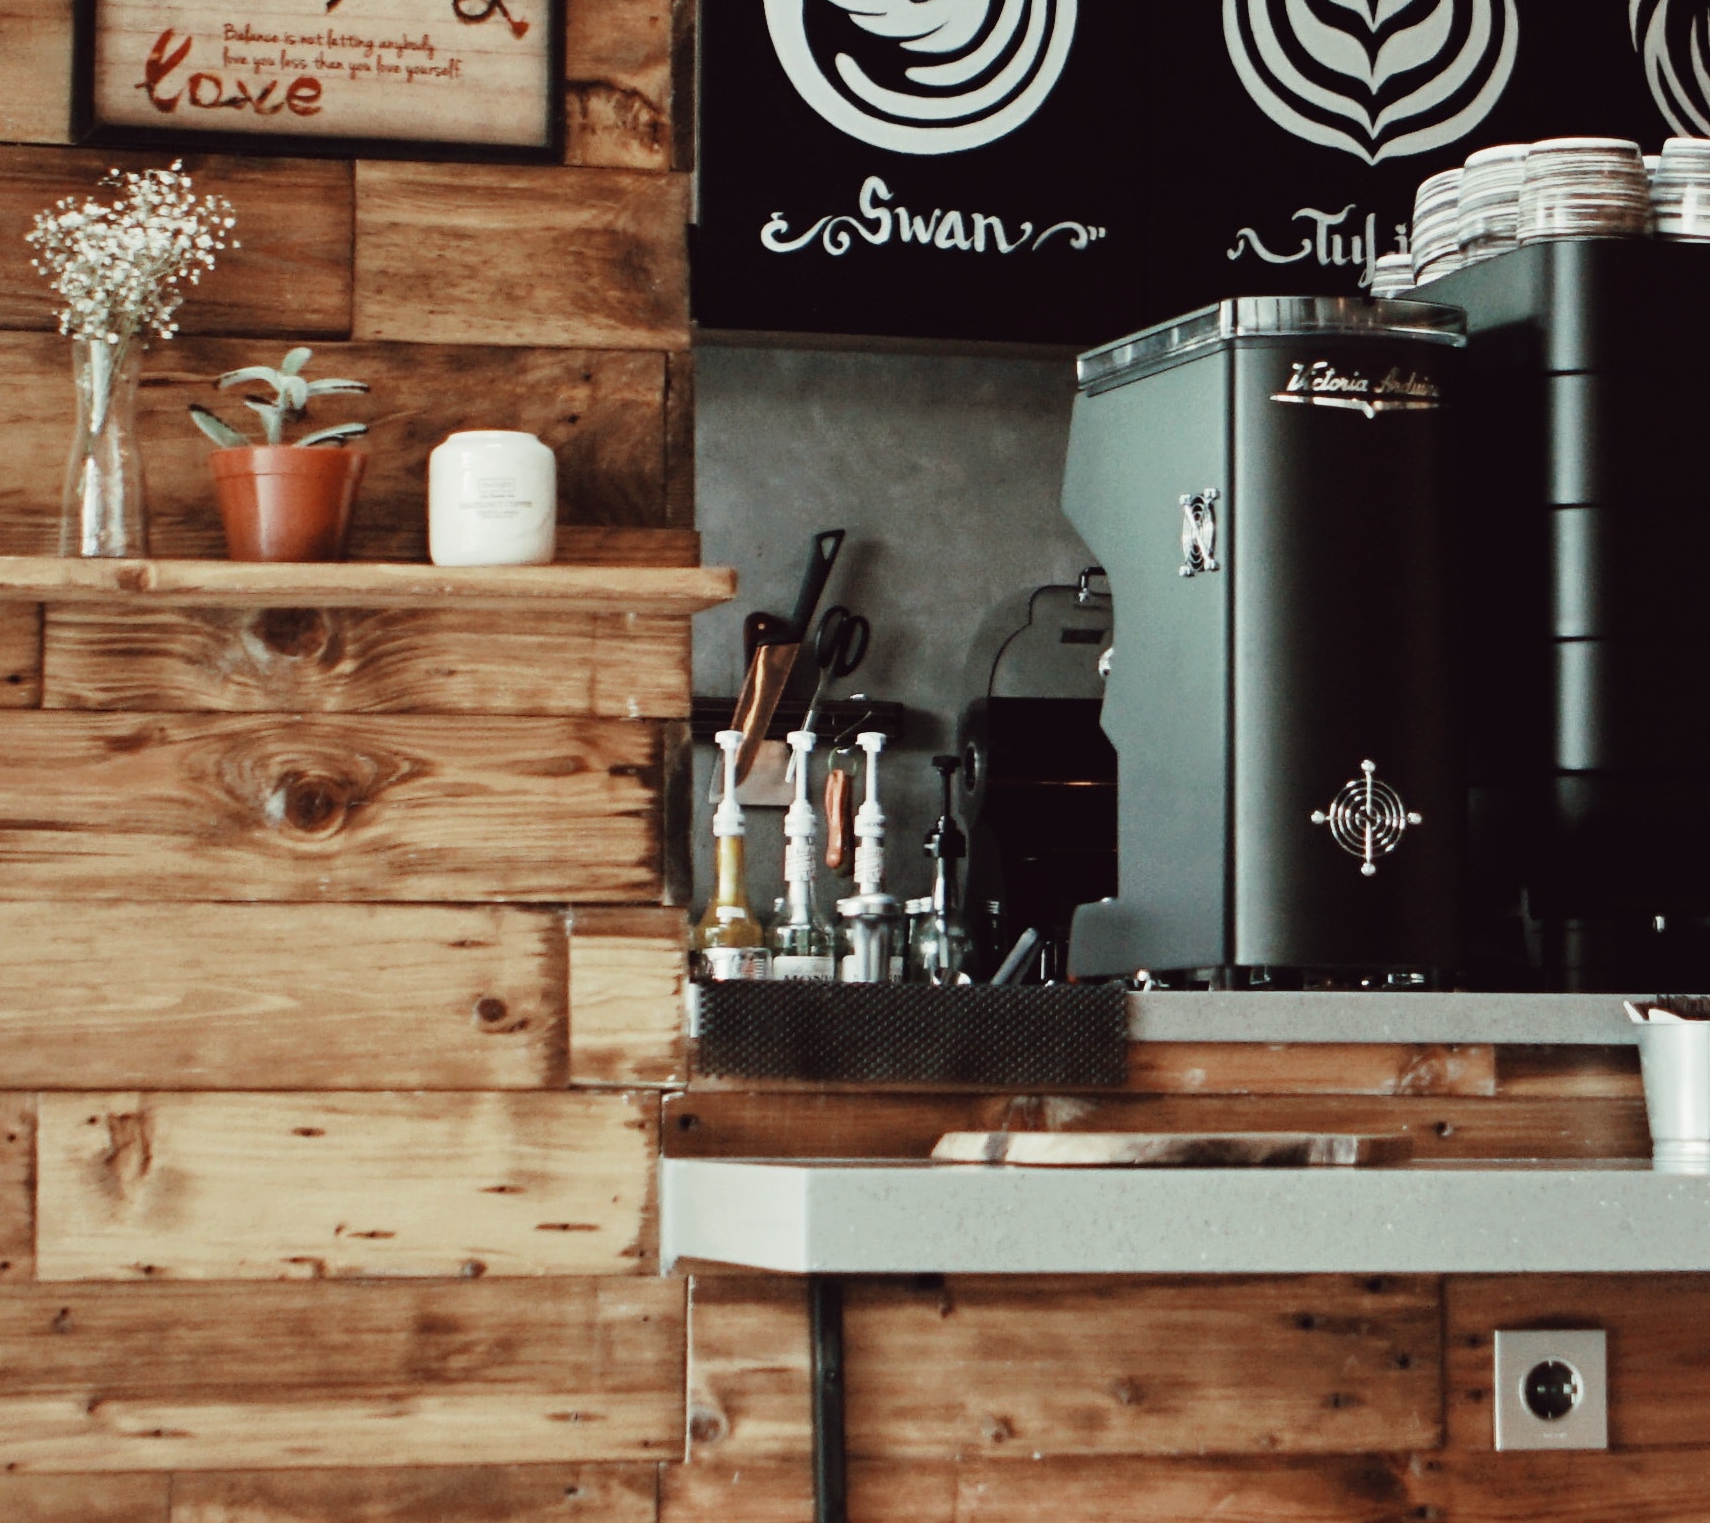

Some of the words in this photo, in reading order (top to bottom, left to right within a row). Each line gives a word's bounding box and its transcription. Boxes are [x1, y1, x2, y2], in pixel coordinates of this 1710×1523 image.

[223, 23, 279, 45] Balance
[283, 31, 297, 46] is
[300, 34, 325, 47] not
[327, 28, 375, 59] letting
[378, 33, 437, 61] anybody
[134, 28, 323, 117] love
[223, 46, 249, 68] love
[252, 56, 276, 75] you
[280, 49, 308, 71] less
[314, 50, 346, 70] than
[348, 61, 373, 80] you
[376, 54, 402, 76] love
[823, 176, 1033, 256] Swan
[1286, 361, 1369, 392] Victoria
